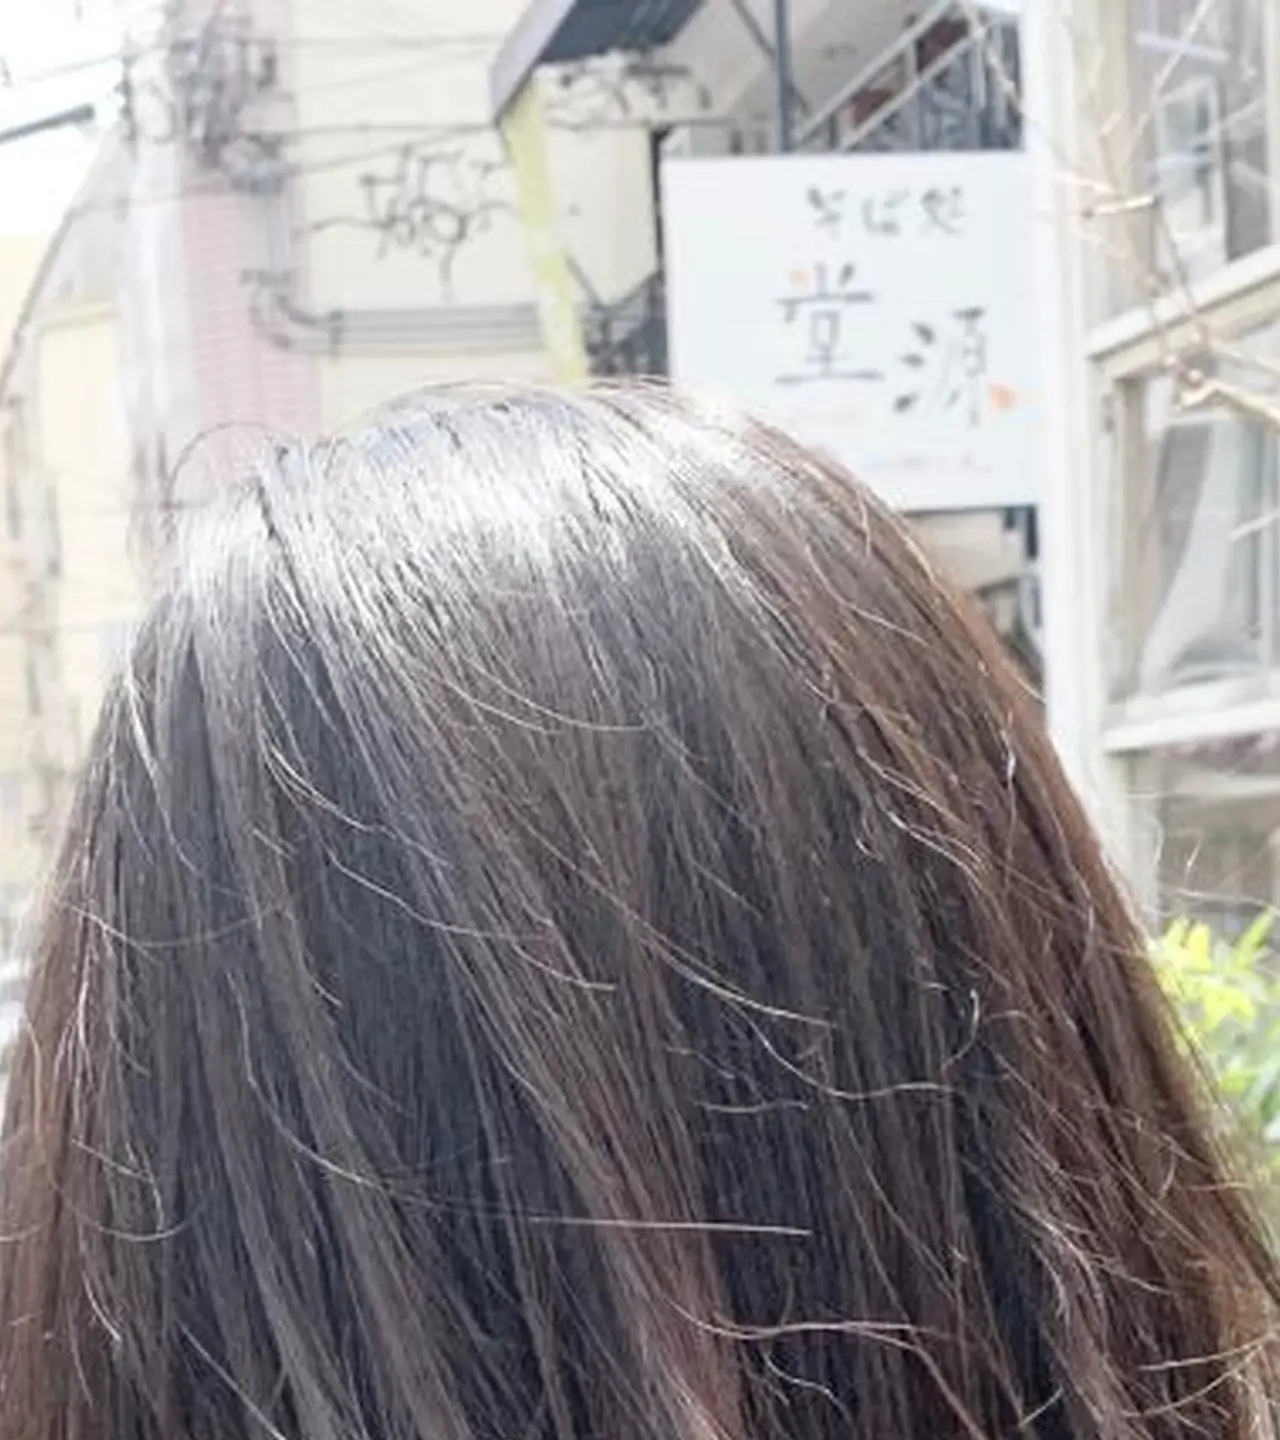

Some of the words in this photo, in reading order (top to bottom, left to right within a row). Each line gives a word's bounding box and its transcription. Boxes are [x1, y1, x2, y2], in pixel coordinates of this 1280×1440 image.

[805, 184, 966, 237] そば処
[773, 260, 989, 430] 堂源
